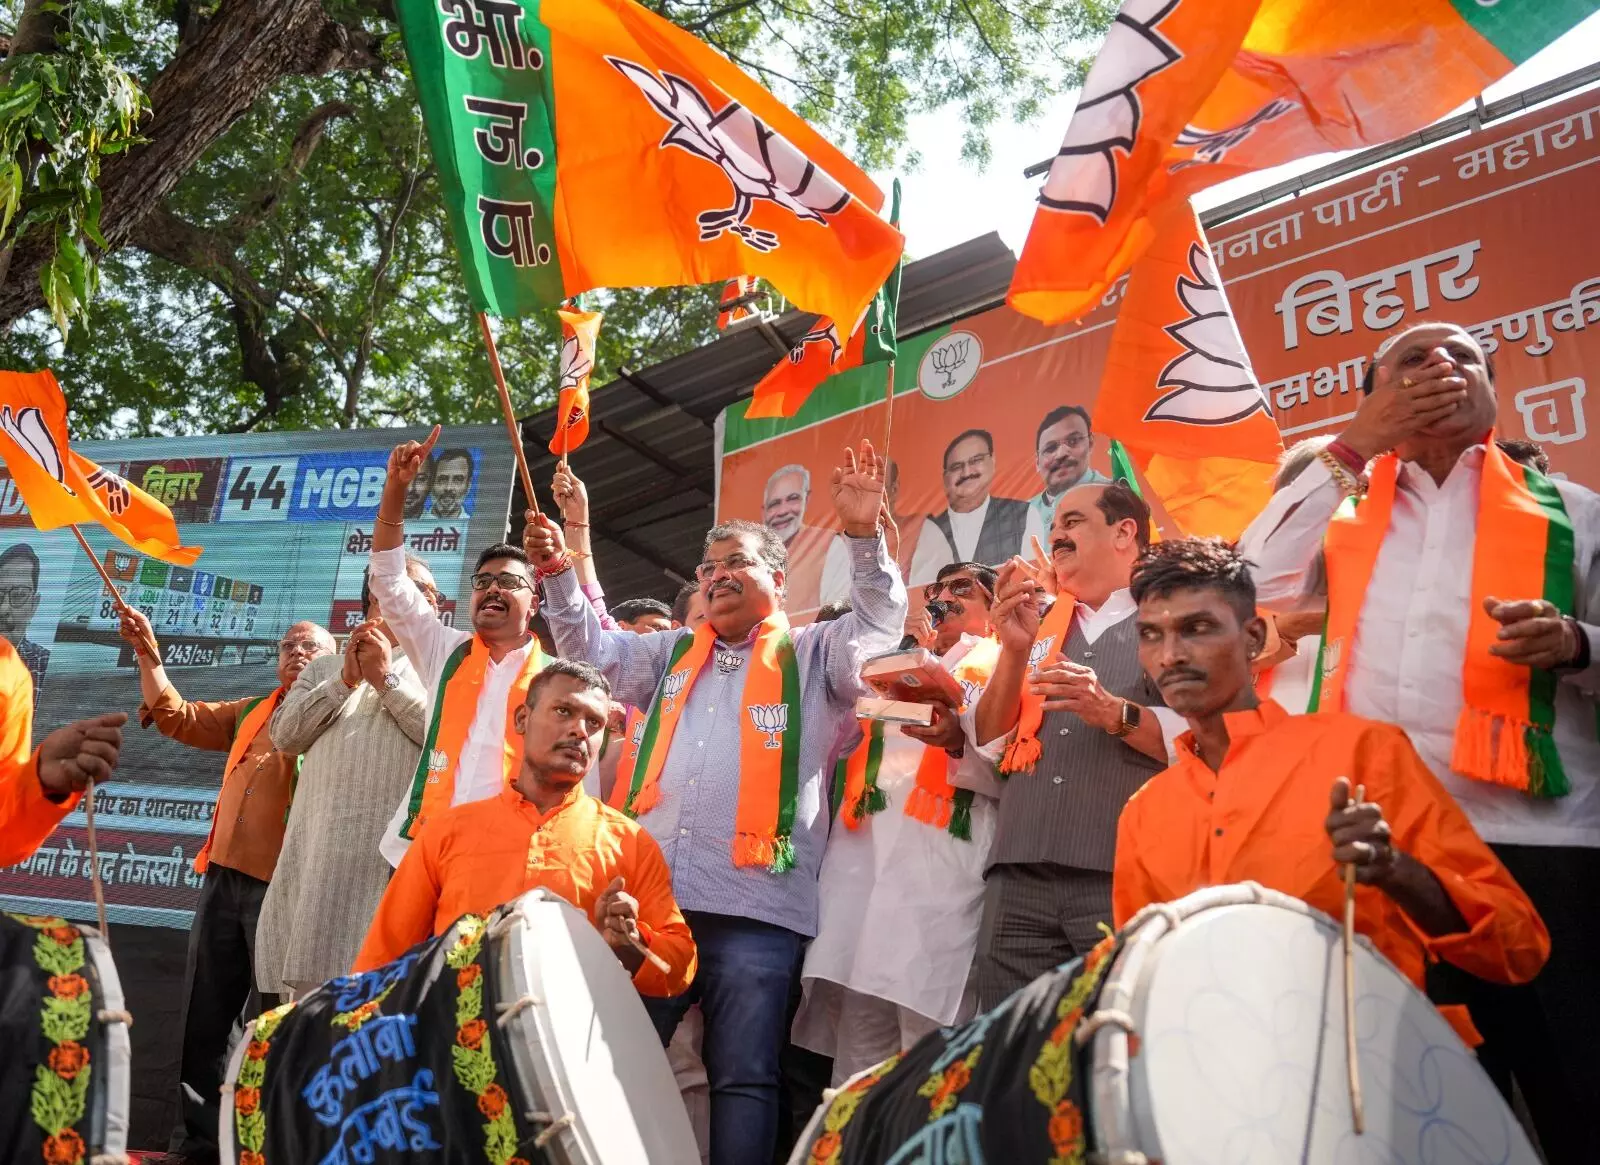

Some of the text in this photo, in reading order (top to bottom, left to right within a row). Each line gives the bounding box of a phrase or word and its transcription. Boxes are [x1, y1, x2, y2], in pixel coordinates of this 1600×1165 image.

[464, 95, 544, 170] ज.
[1312, 167, 1408, 226] पार्टी
[1453, 104, 1600, 180] महारा
[477, 195, 551, 267] पा.
[1274, 238, 1481, 351] बिहार
[228, 465, 287, 511] 44
[300, 466, 386, 509] MGB
[411, 526, 461, 551] नतीजे
[166, 608, 180, 625] 21
[165, 643, 214, 666] 243/243
[59, 838, 82, 878] के
[119, 841, 183, 888] तेजस्वी
